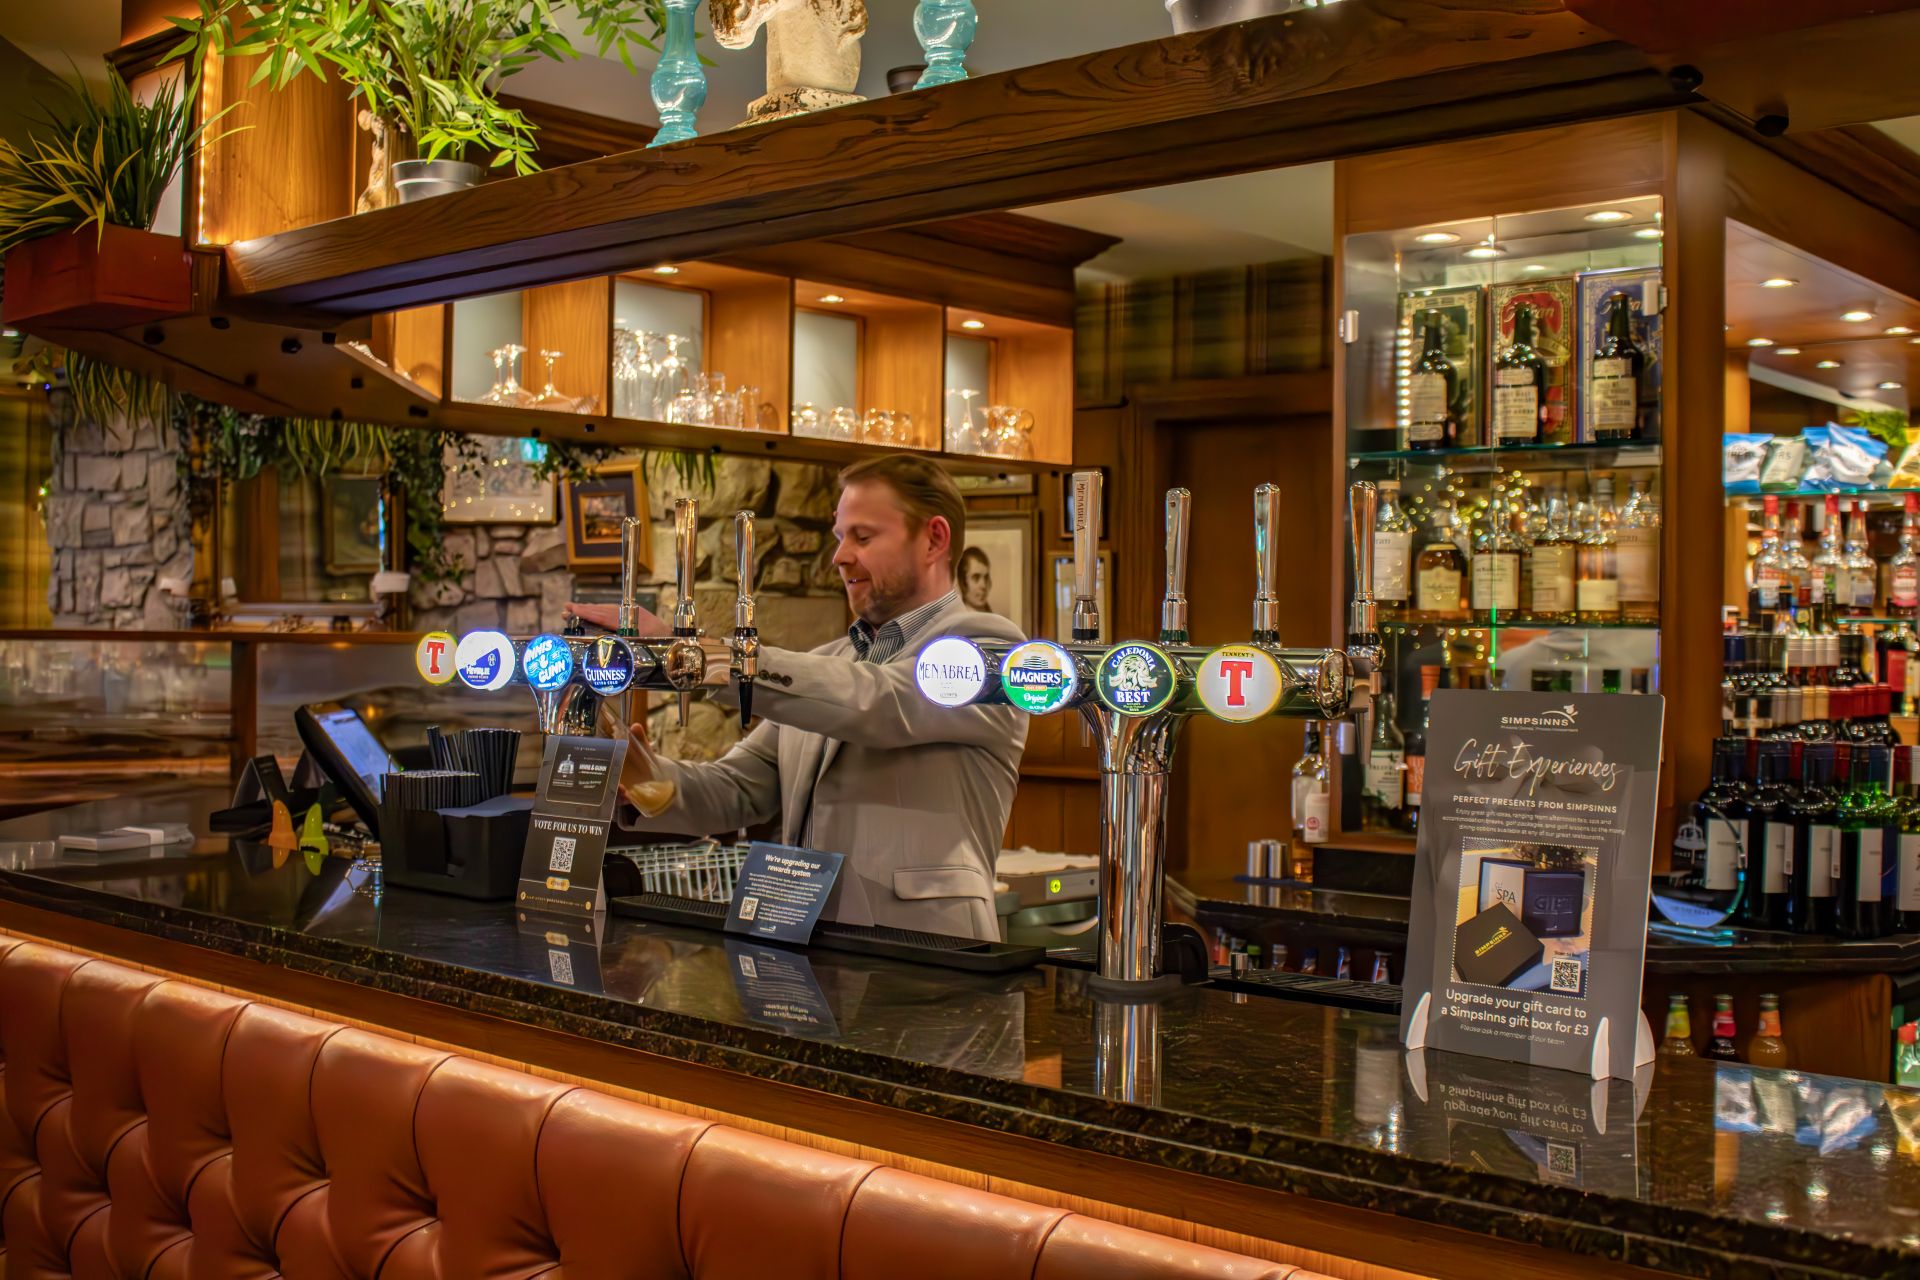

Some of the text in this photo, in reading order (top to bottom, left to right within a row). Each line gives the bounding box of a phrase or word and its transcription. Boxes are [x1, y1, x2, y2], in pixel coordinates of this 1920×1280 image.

[1077, 483, 1086, 531] MENABREA
[426, 641, 445, 675] T
[540, 654, 548, 669] &
[1112, 647, 1156, 671] CALEDONIA
[538, 660, 565, 683] GUNN
[585, 668, 626, 681] GUINNESS
[919, 662, 981, 681] MENABREA
[1011, 669, 1061, 684] MAGNERS
[1219, 660, 1254, 707] T
[1023, 692, 1048, 704] Original
[1116, 691, 1151, 703] BEST
[1500, 716, 1569, 727] SIMPSINNS
[1454, 738, 1624, 796] Gift Experiences
[1453, 795, 1617, 813] PERFECT PRESENTS FROM SIMPSINNS
[534, 819, 604, 836] VOTE FOR US TO WIN
[765, 854, 781, 863] We're
[781, 857, 810, 869] upgrading
[767, 865, 811, 878] rewards system
[1496, 888, 1516, 904] SPA
[1445, 988, 1587, 1018] Upgrade your gift card to
[1441, 1004, 1589, 1036] a SimpsInns gift box for £3
[1459, 1023, 1481, 1033] Please
[1481, 1027, 1492, 1035] ask
